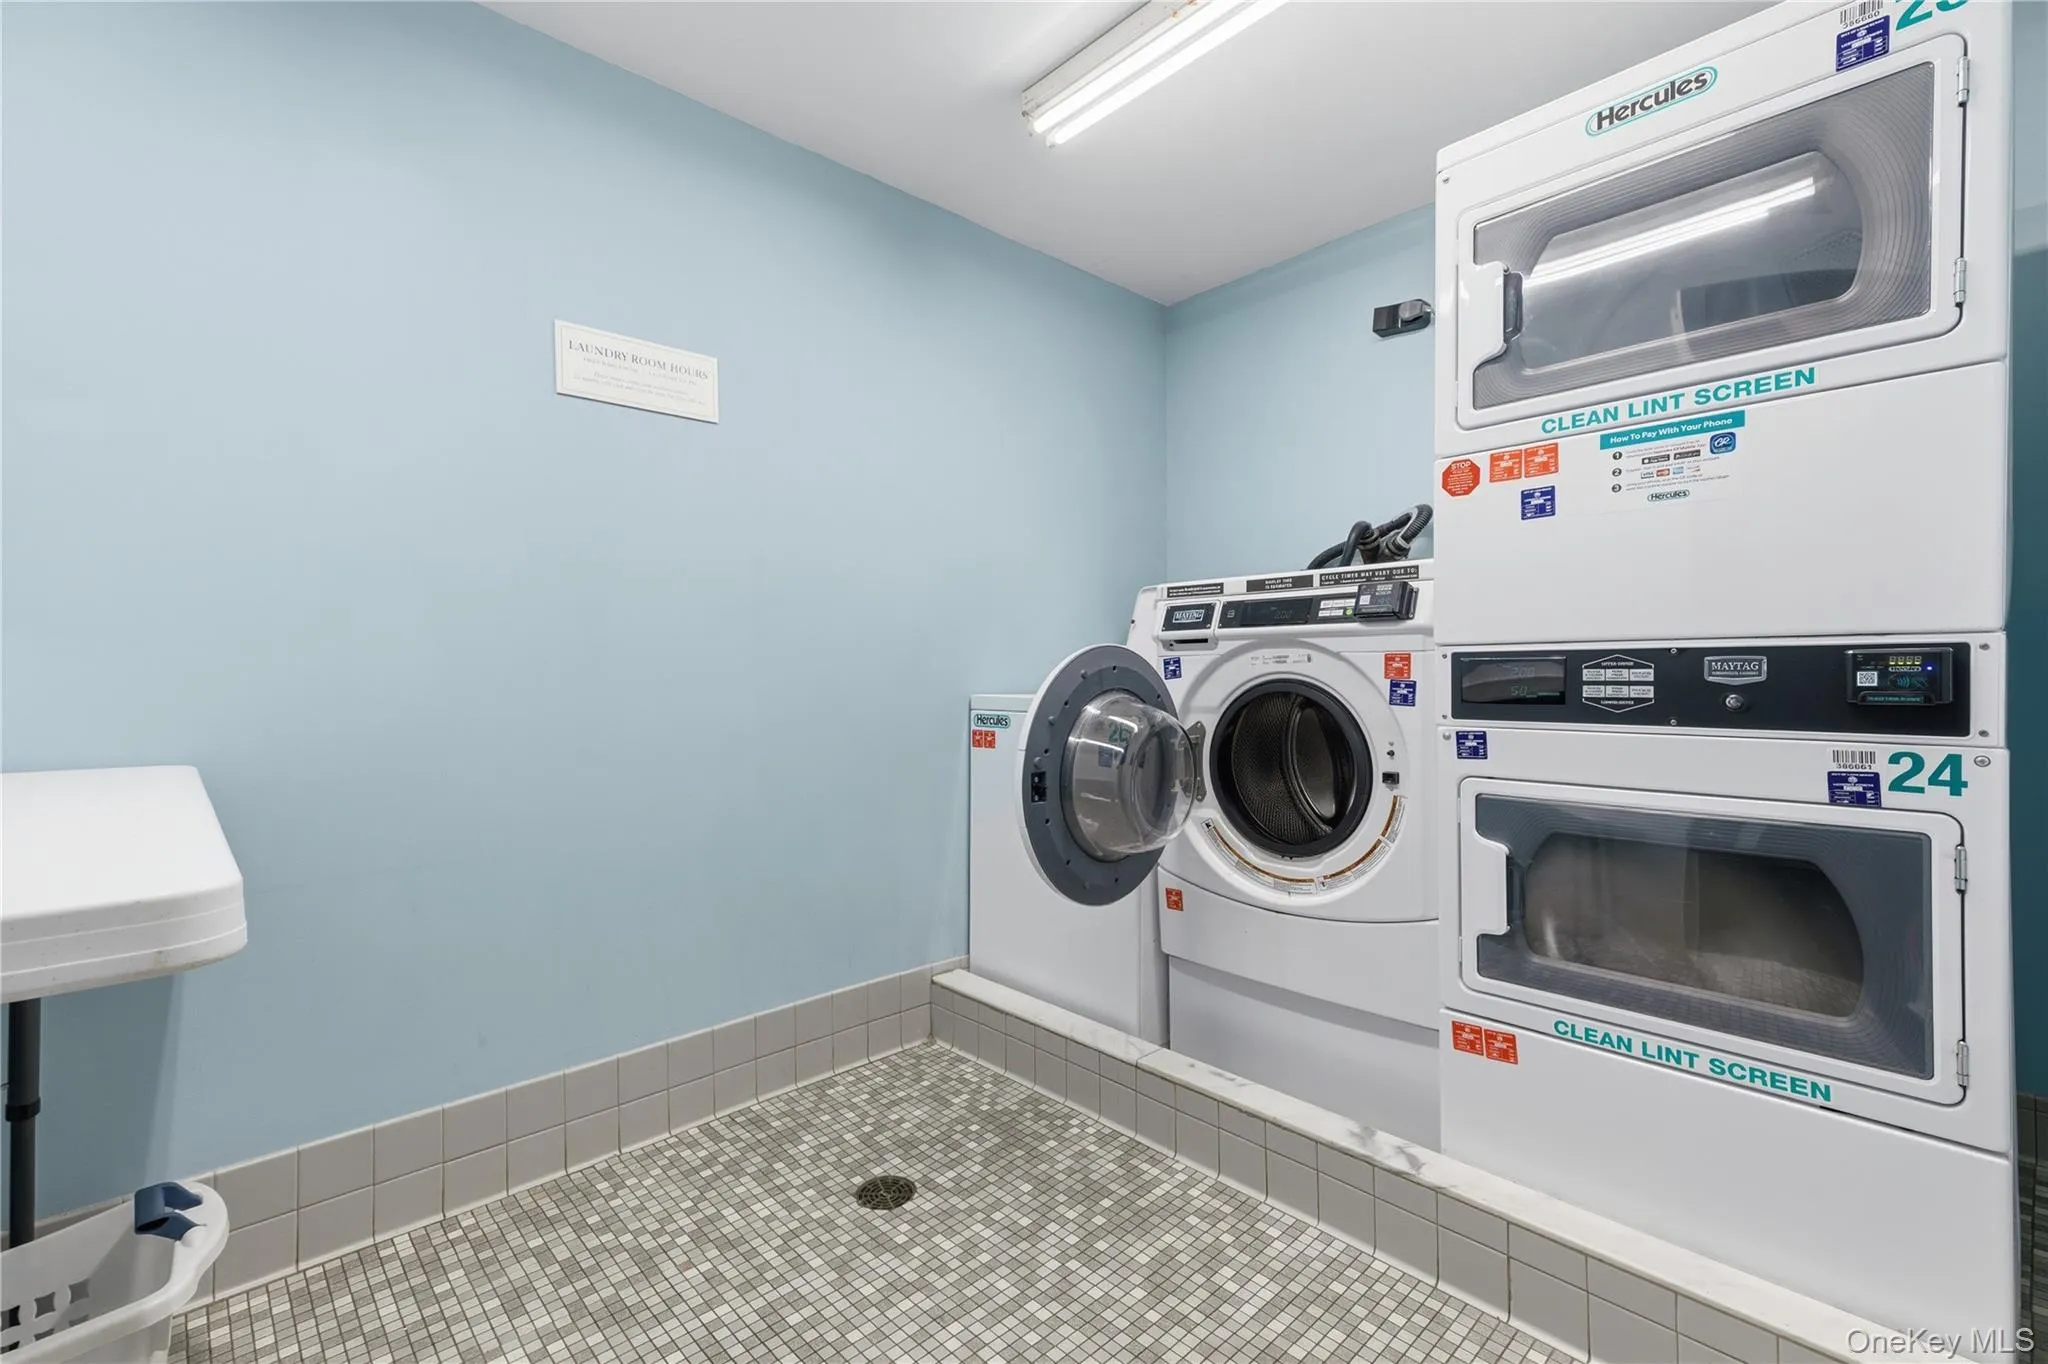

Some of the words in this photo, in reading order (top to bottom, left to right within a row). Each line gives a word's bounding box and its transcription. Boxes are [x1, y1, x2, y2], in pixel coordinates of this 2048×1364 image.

[1596, 71, 1708, 131] Hercules
[568, 340, 629, 361] LAUNDRY
[631, 354, 667, 371] ROOM
[670, 362, 709, 380] HOURS
[1541, 406, 1619, 434] CLEAN
[1628, 394, 1684, 418] LINT
[1695, 368, 1815, 404] SCREEN
[1610, 435, 1629, 445] How
[1630, 433, 1641, 441] To
[1642, 431, 1657, 440] Pay
[1658, 427, 1680, 437] With
[1681, 423, 1702, 433] Your
[1703, 418, 1733, 429] Phone
[1451, 461, 1472, 471] STOP
[1650, 489, 1688, 501] Hercules
[1321, 574, 1339, 582] CYCLE
[1174, 610, 1205, 621] MAYTAG
[1711, 662, 1760, 671] MAYTAG
[976, 714, 1009, 727] Hercules
[1888, 752, 1968, 796] 24
[1554, 1020, 1632, 1053] CLEAN
[1642, 1041, 1699, 1068] LINT
[1709, 1058, 1831, 1102] SCREEN
